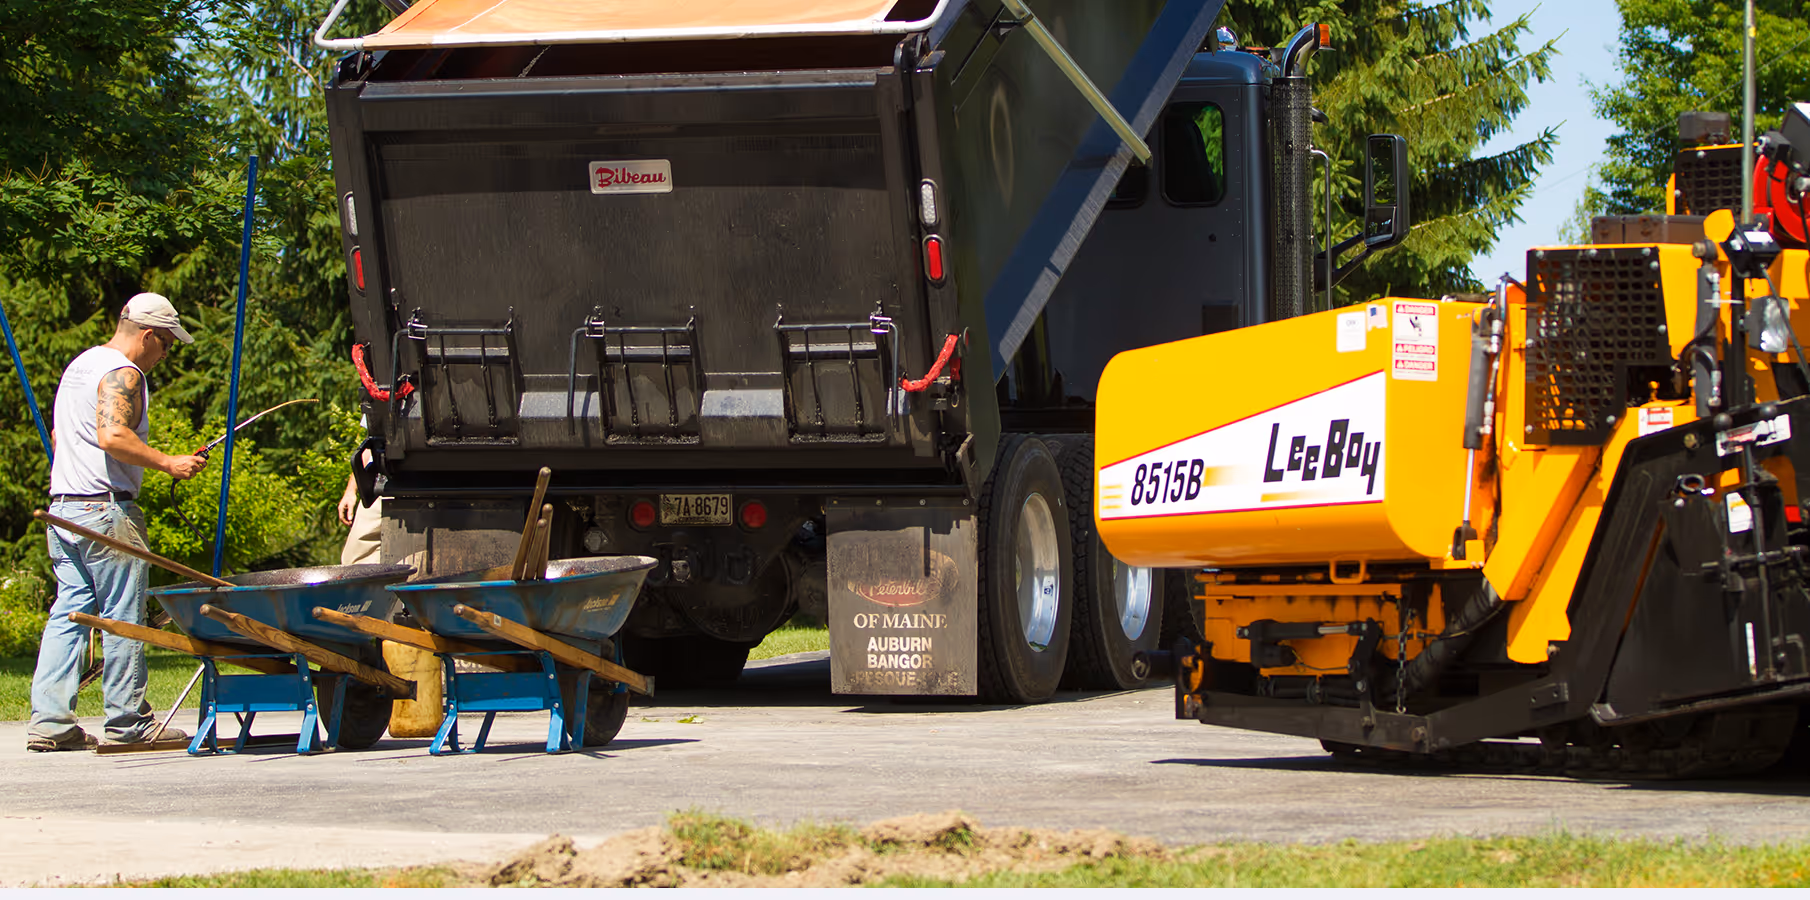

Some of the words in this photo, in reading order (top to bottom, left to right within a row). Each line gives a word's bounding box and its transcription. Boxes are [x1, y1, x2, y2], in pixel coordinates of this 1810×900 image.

[595, 167, 666, 188] Bibeau
[1130, 458, 1204, 506] 8515B
[1263, 418, 1381, 495] LeeBoy
[868, 577, 934, 597] eterbil
[853, 613, 880, 629] OF
[882, 613, 948, 629] MAINE
[867, 636, 932, 652] AUBURN
[867, 653, 933, 669] BANGOR
